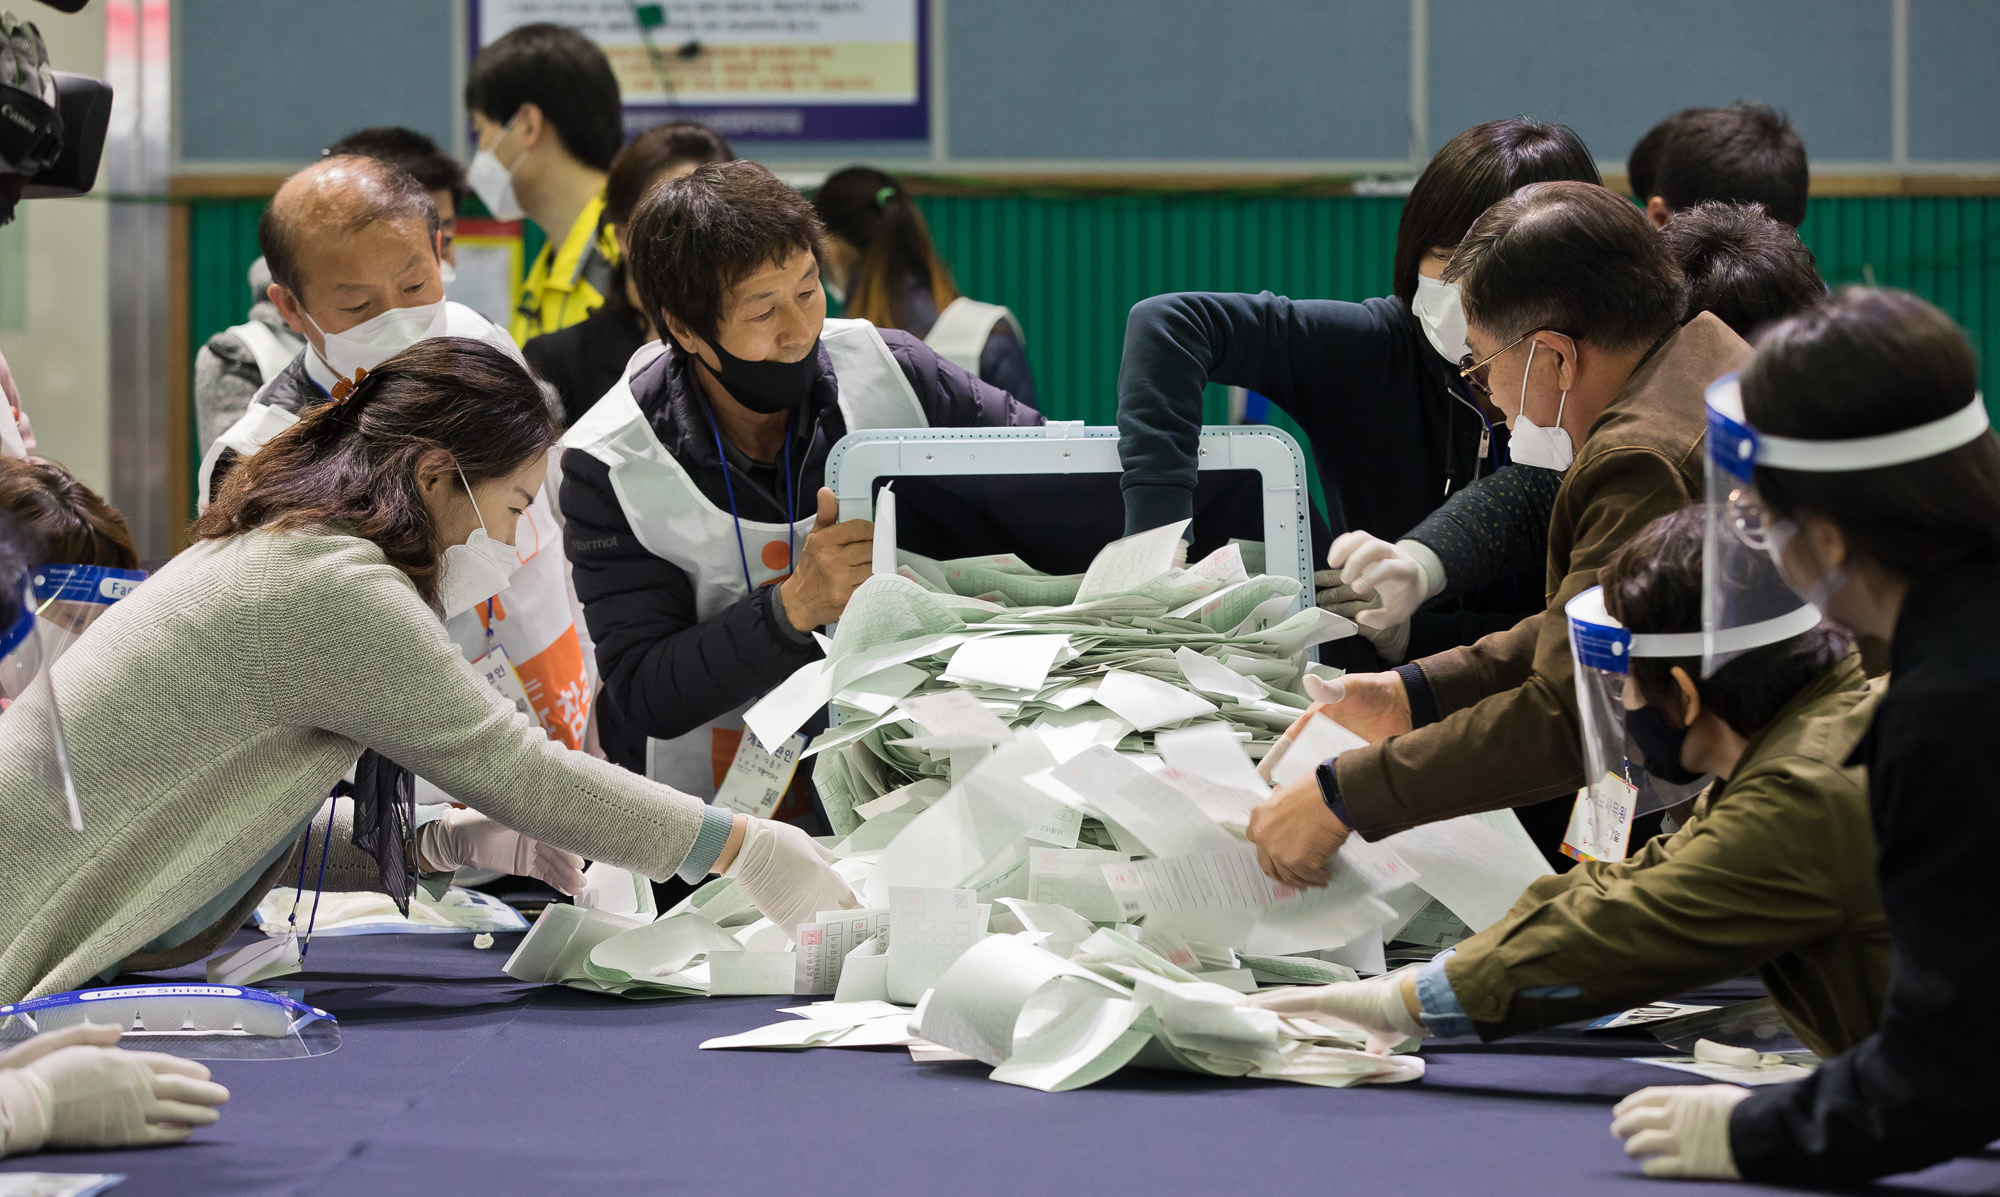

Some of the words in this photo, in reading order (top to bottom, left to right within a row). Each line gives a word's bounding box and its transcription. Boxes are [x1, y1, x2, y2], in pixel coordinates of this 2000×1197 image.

[1, 104, 37, 134] Canon
[572, 535, 618, 551] Marmot
[112, 582, 134, 597] Fac
[747, 732, 794, 763] 개표관인
